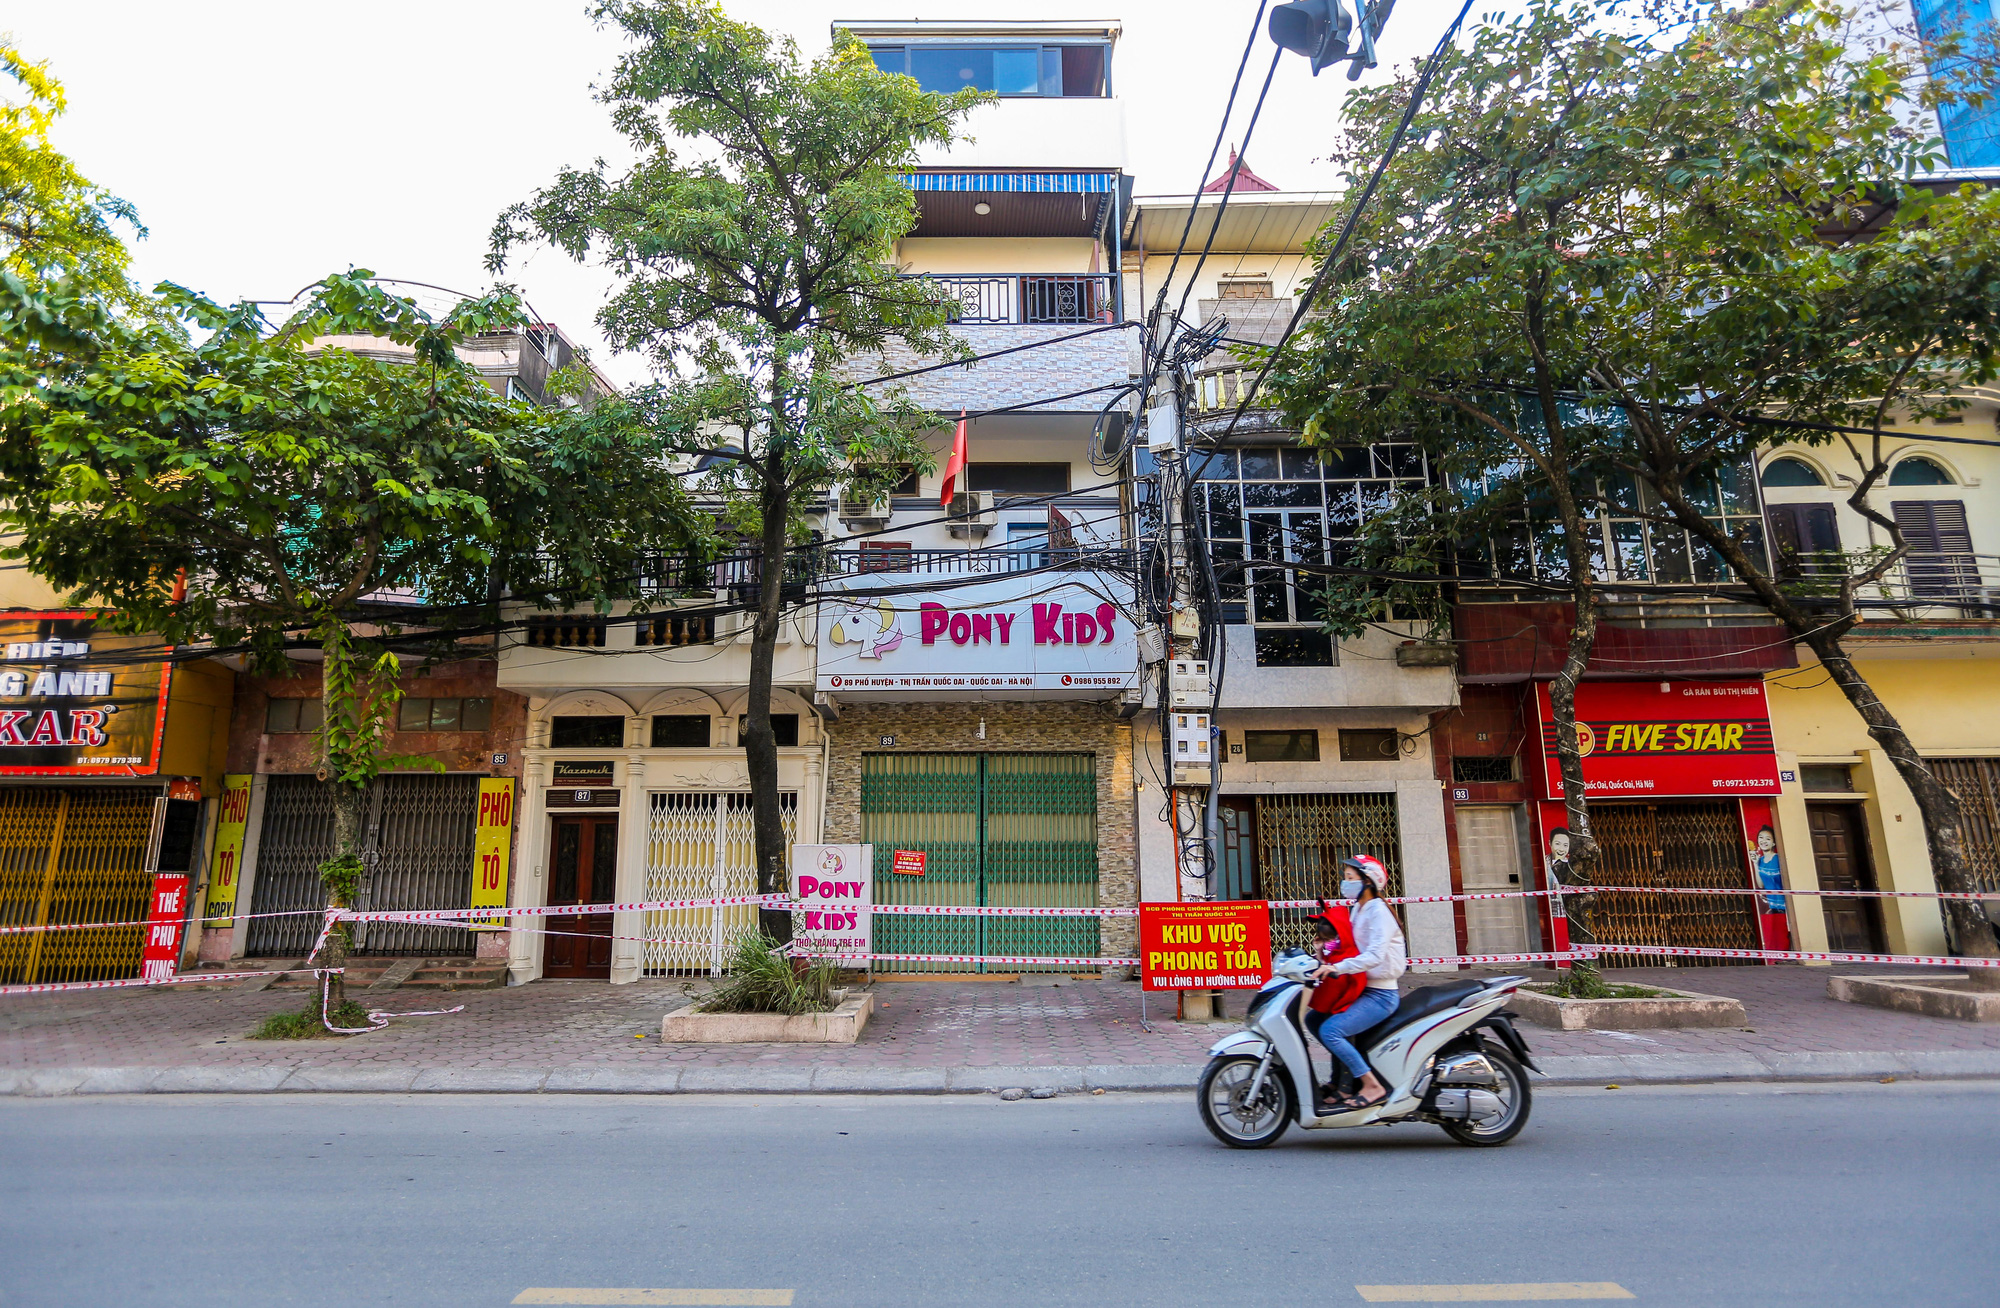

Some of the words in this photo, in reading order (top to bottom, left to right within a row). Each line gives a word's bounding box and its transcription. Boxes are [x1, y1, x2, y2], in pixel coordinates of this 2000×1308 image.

[920, 602, 1015, 646] PONY
[1032, 602, 1116, 646] KIDS
[844, 678, 853, 686] 89
[855, 676, 869, 686] PHỐ
[871, 677, 894, 687] HUYỆN
[900, 678, 911, 687] THỊ
[933, 676, 952, 686] QUỐC
[953, 678, 965, 686] OAI
[970, 676, 989, 686] QUỐC
[991, 678, 1003, 686] OAI
[1008, 677, 1018, 686] HÀ
[1020, 677, 1033, 687] NỘI
[1074, 677, 1092, 685] 0986
[1107, 677, 1121, 685] 892
[1683, 687, 1694, 696] GÀ
[1713, 687, 1727, 695] BÙI
[1727, 688, 1740, 697] THỊ
[882, 736, 893, 745] 89
[1605, 724, 1668, 752] FIVE
[1674, 723, 1744, 751] STAR
[494, 755, 505, 763] 85
[1608, 779, 1624, 790] Quốc
[1725, 779, 1774, 787] 0972.192.378
[1782, 772, 1793, 780] 95
[221, 781, 248, 823] PHÔ
[577, 791, 588, 800] 87
[1456, 791, 1466, 799] 93
[479, 785, 511, 827] PHÔ
[218, 843, 235, 886] TÔ
[482, 847, 501, 890] TÔ
[798, 875, 865, 898] PONY
[158, 885, 182, 913] THẾ
[207, 901, 233, 918] COPY
[805, 911, 858, 930] KIDS
[151, 925, 176, 950] PHỤ
[854, 939, 866, 947] EM
[1162, 925, 1202, 943] KHU
[1207, 922, 1247, 947] VỰC
[1149, 951, 1217, 970] PHONG
[1223, 944, 1262, 970] TỎA
[1152, 977, 1167, 986] VUI
[1169, 974, 1192, 986] LÒNG
[1194, 977, 1204, 986] ĐI
[1205, 974, 1236, 986] HƯỚNG
[1238, 973, 1262, 985] KHÁC
